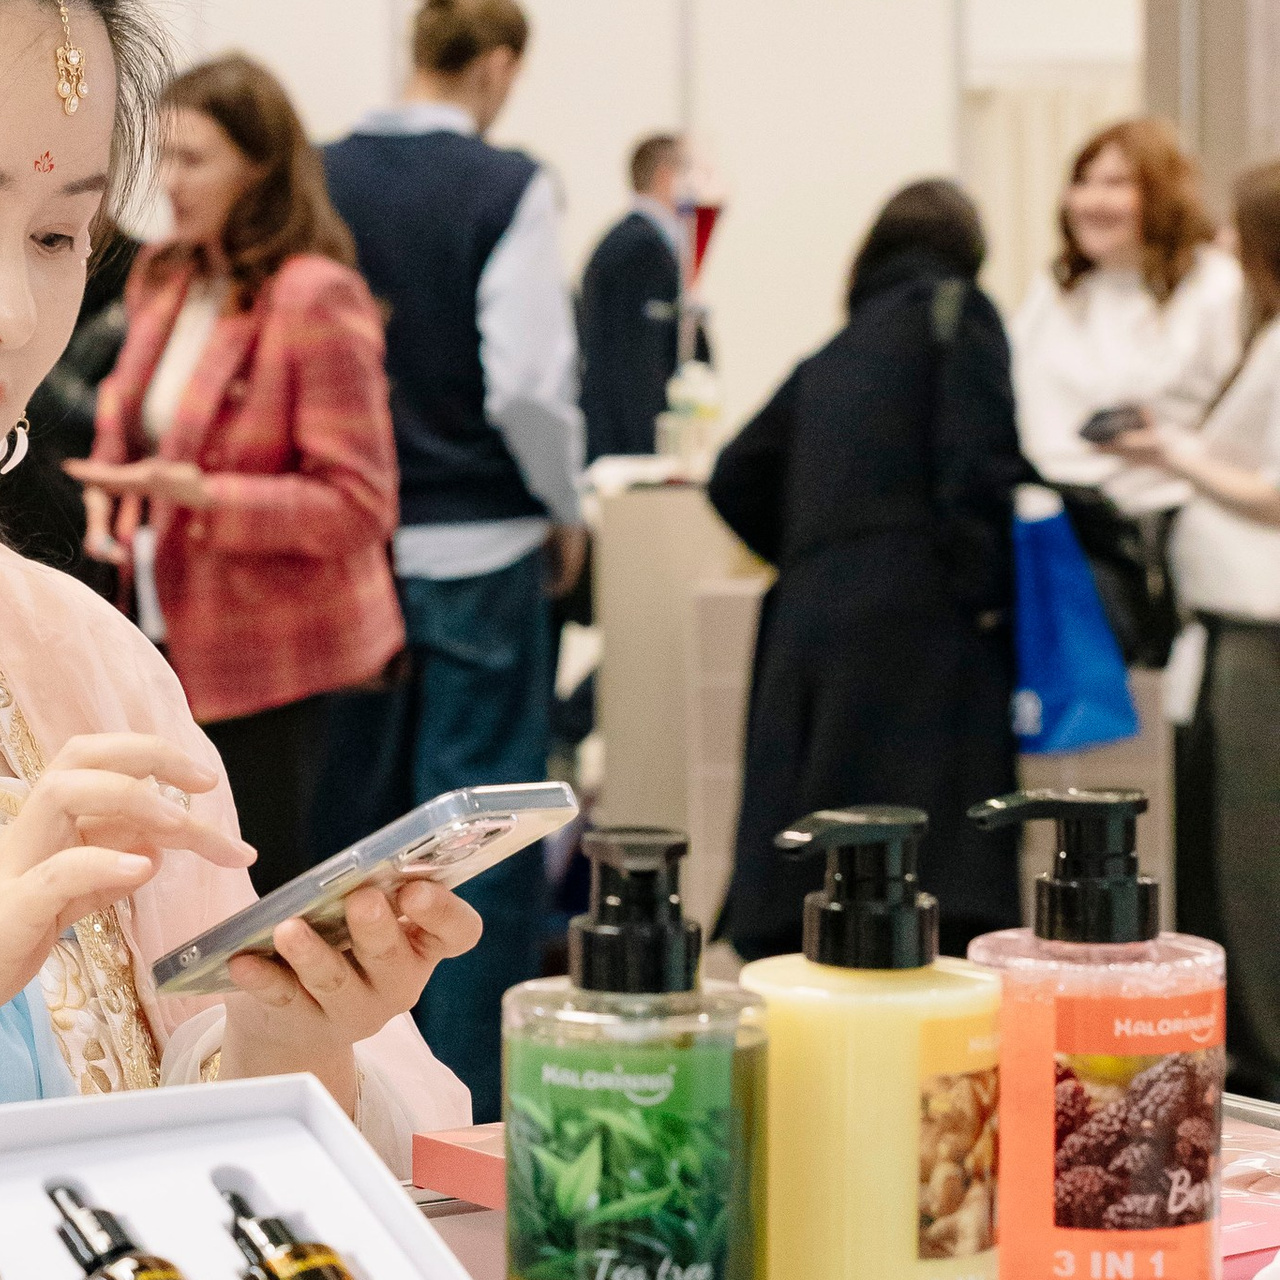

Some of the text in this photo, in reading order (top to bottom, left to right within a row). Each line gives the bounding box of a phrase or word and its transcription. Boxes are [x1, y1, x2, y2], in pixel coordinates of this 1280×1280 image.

[1053, 1249, 1165, 1280] 3 IN 1
